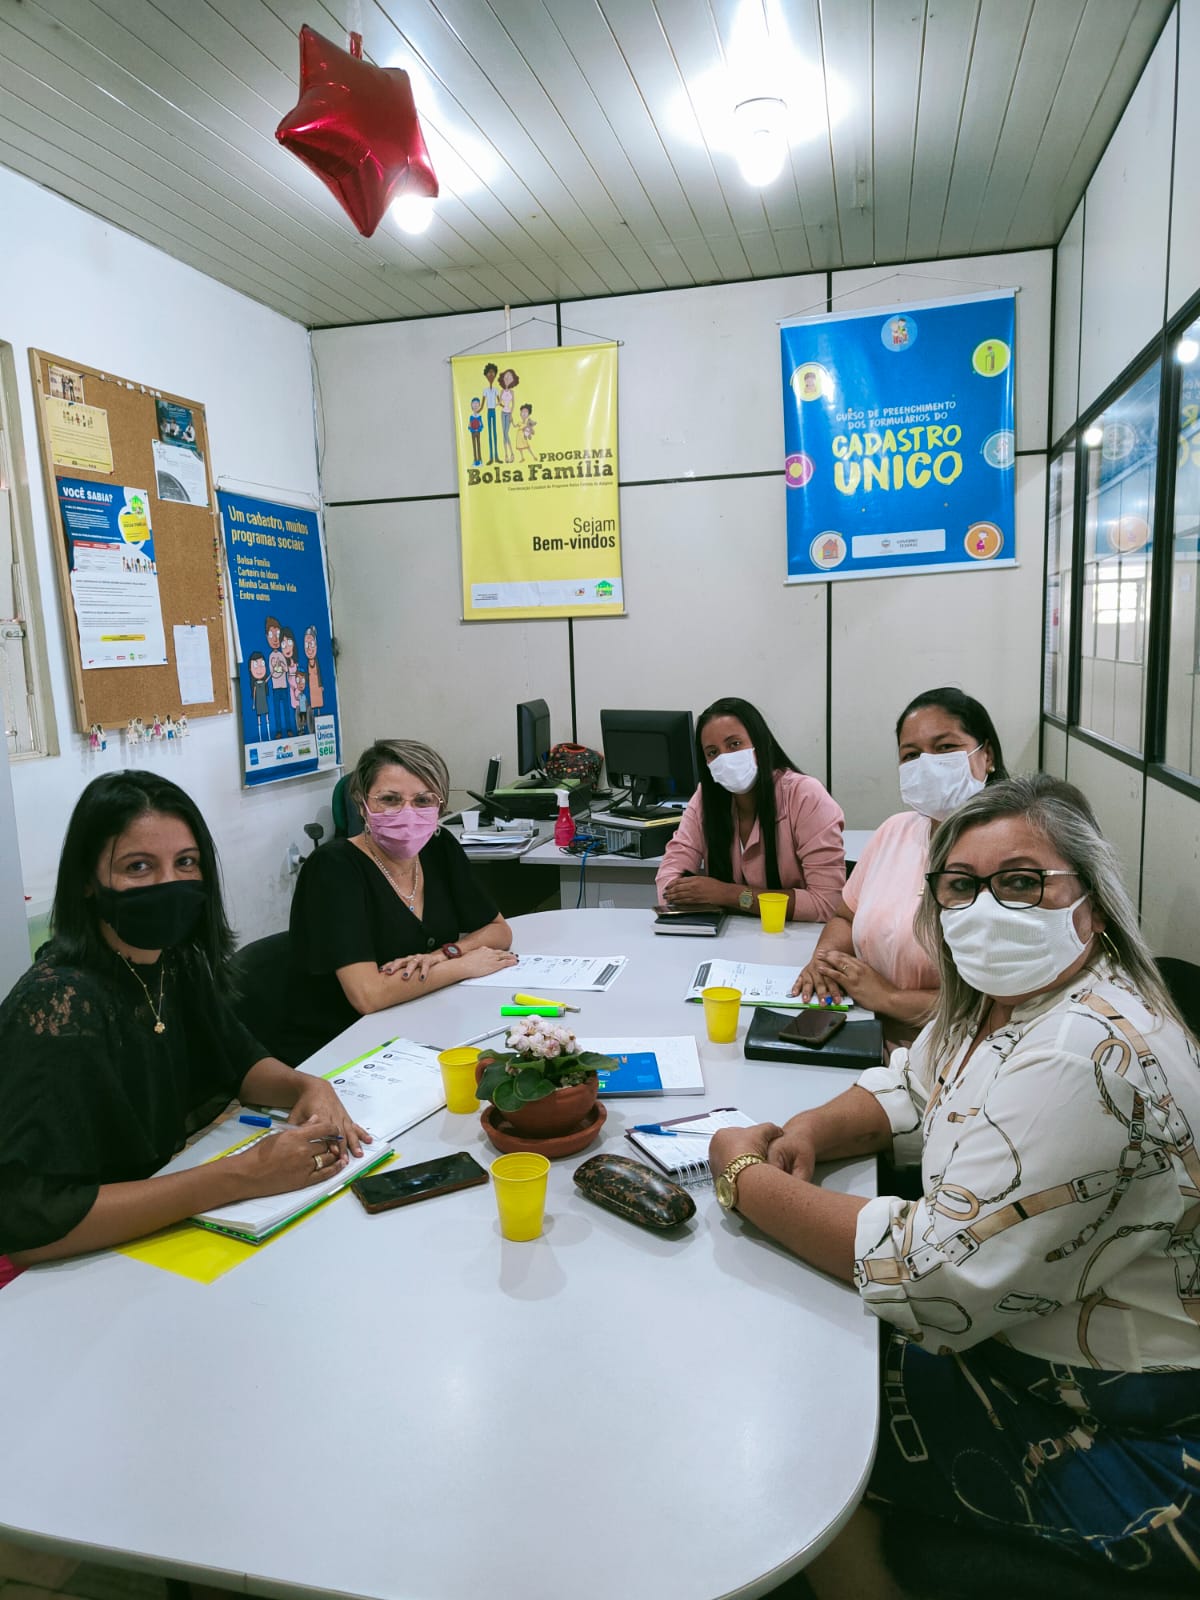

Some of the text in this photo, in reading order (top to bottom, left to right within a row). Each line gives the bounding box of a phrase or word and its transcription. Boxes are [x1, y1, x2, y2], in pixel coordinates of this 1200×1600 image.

[836, 400, 957, 422] CURSO DE PREENCHIMENTO
[848, 419, 866, 430] DOS
[934, 411, 948, 421] DO
[831, 424, 962, 459] CADASTRO
[539, 448, 613, 462] PROGRAMA
[467, 466, 524, 486] Bolsa
[528, 460, 614, 482] Família
[62, 486, 113, 503] VOCÊ SABIA?
[228, 504, 309, 536] Um cadastro, muitos
[573, 516, 616, 536] Sejam
[232, 529, 304, 551] programas sociais
[532, 533, 616, 552] Bem-vindos
[236, 554, 253, 566] Bolsa
[238, 578, 257, 589] Minha
[286, 582, 297, 593] Vida
[239, 590, 255, 601] Entre
[319, 745, 335, 756] seu.
